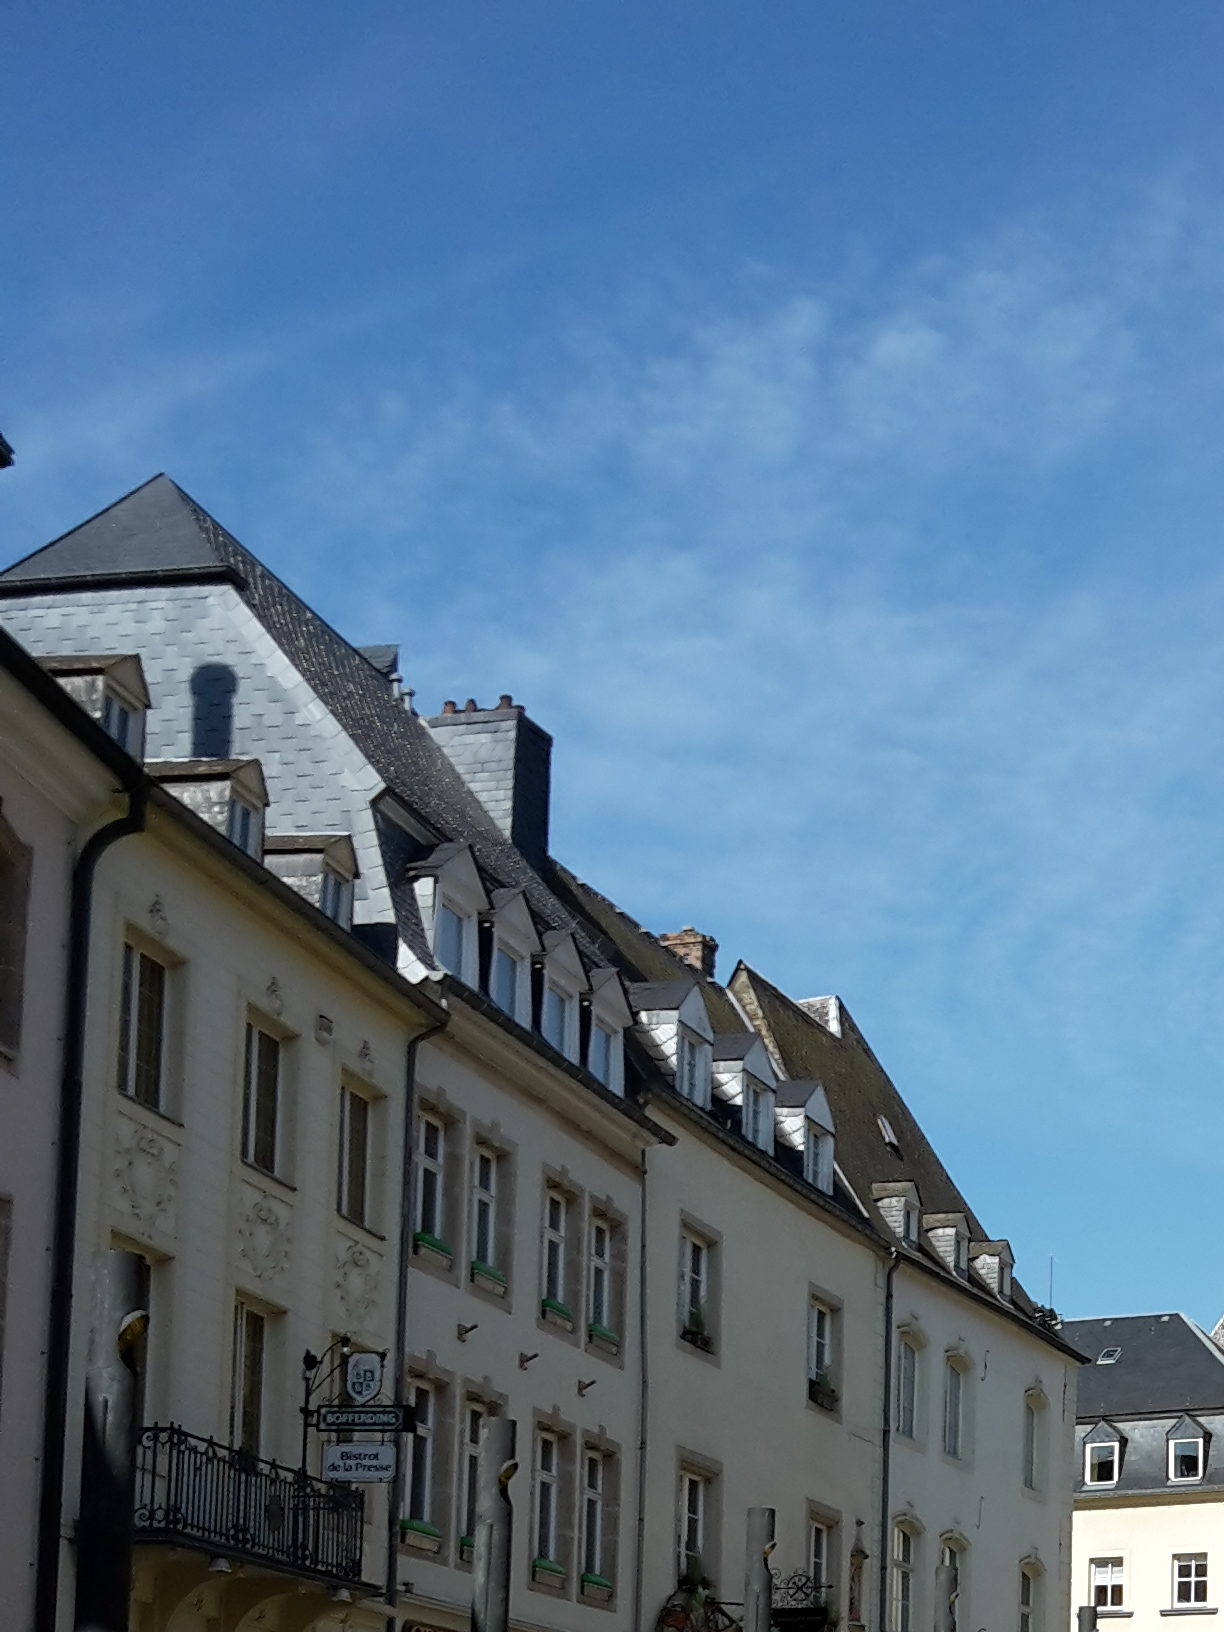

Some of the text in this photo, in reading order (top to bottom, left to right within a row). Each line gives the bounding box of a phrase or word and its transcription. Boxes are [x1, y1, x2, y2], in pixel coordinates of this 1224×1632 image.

[326, 1413, 396, 1424] BOFFERDING
[340, 1451, 379, 1461] Bistrot
[328, 1462, 392, 1472] de la Presse
